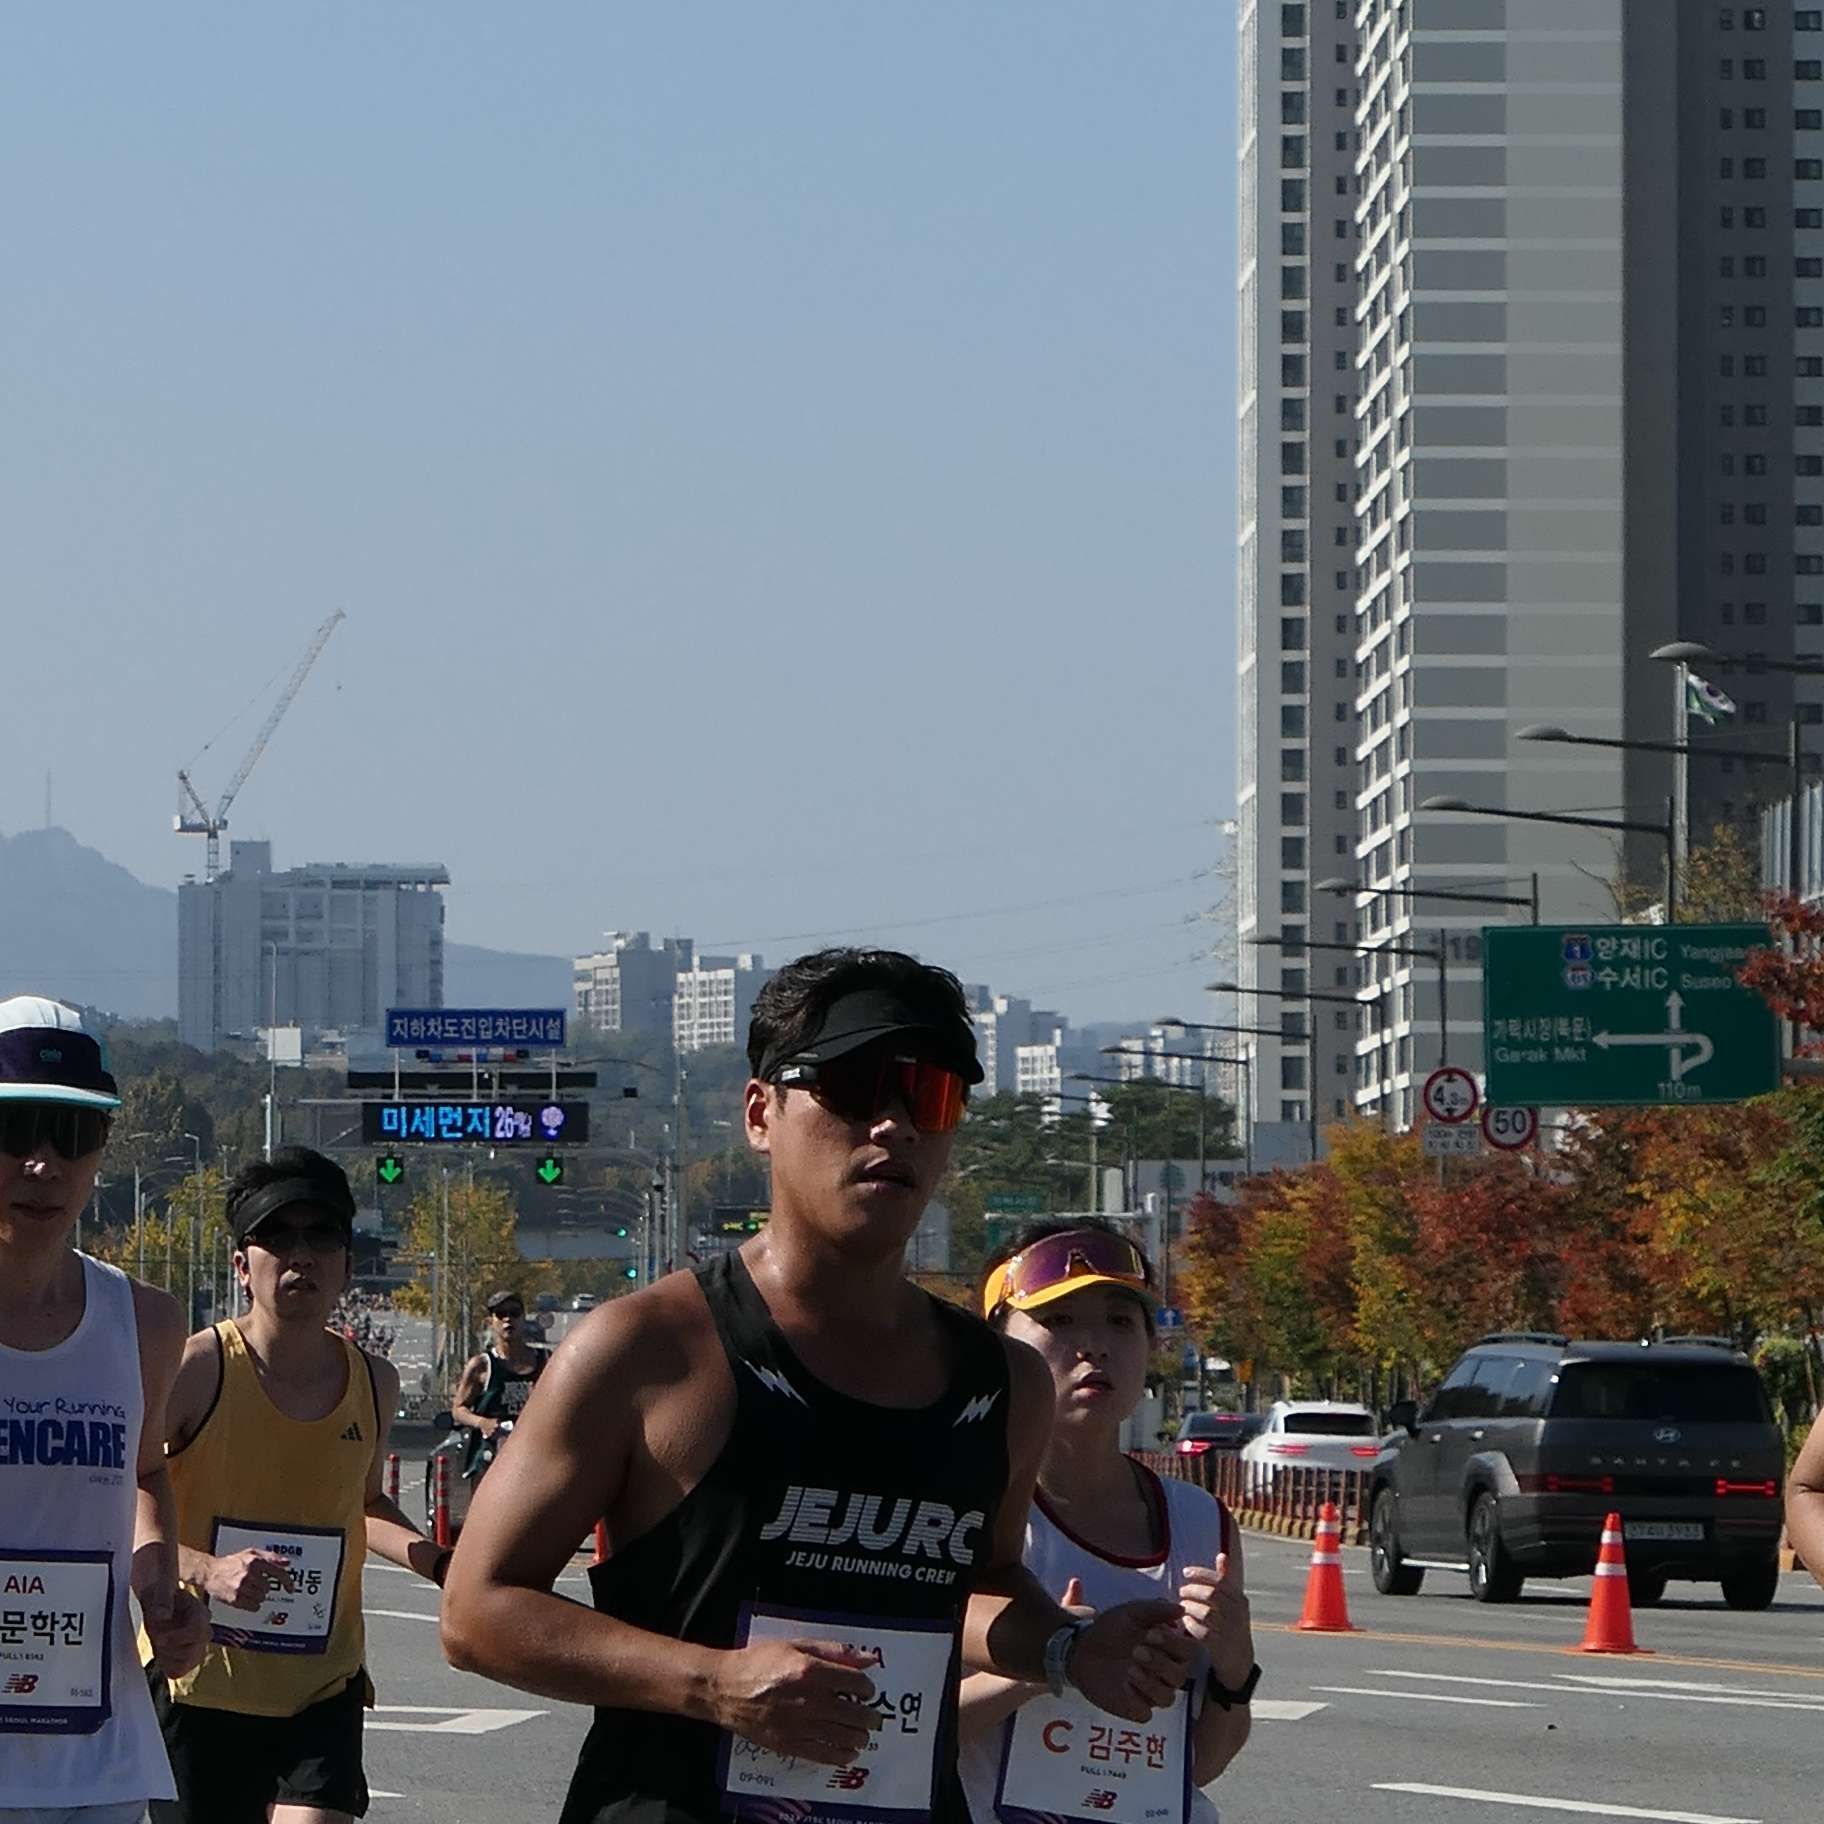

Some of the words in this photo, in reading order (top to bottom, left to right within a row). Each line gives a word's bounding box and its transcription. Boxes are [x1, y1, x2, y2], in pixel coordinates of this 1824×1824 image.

[1595, 936, 1668, 961] 양재IC
[1595, 965, 1669, 991] 수서IC
[392, 1017, 562, 1040] 지하차도진입차단시설
[1553, 1046, 1587, 1063] Mkt
[382, 1105, 491, 1139] 미세먼지
[1495, 1109, 1527, 1134] 50
[4, 1396, 51, 1414] Your
[55, 1397, 126, 1420] Running
[759, 1484, 986, 1566] JEJURC
[784, 1550, 829, 1570] JEJU
[830, 1557, 913, 1580] RUNNING
[3, 1575, 46, 1595] AIA
[860, 1690, 923, 1735] 수연
[1042, 1719, 1074, 1754] C
[1087, 1725, 1168, 1769] 김주현
